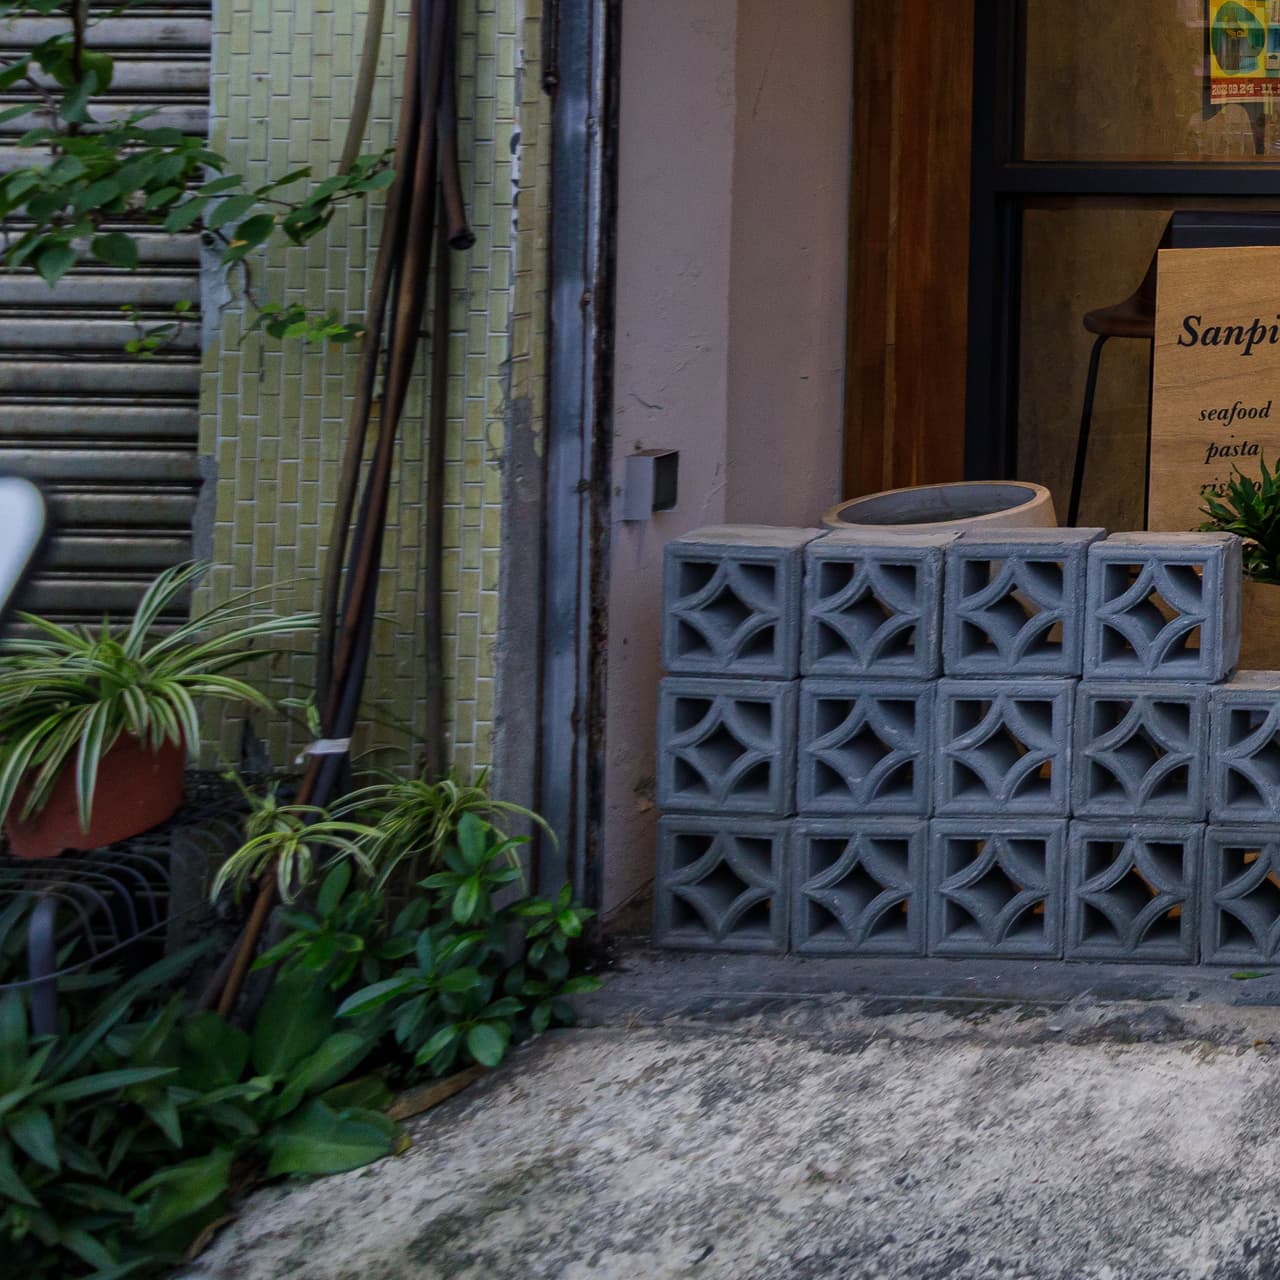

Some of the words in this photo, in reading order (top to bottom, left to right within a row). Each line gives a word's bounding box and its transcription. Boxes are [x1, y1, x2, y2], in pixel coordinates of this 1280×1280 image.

[1198, 400, 1273, 427] seafood
[1204, 441, 1260, 464] pasta
[1200, 472, 1262, 496] riso
